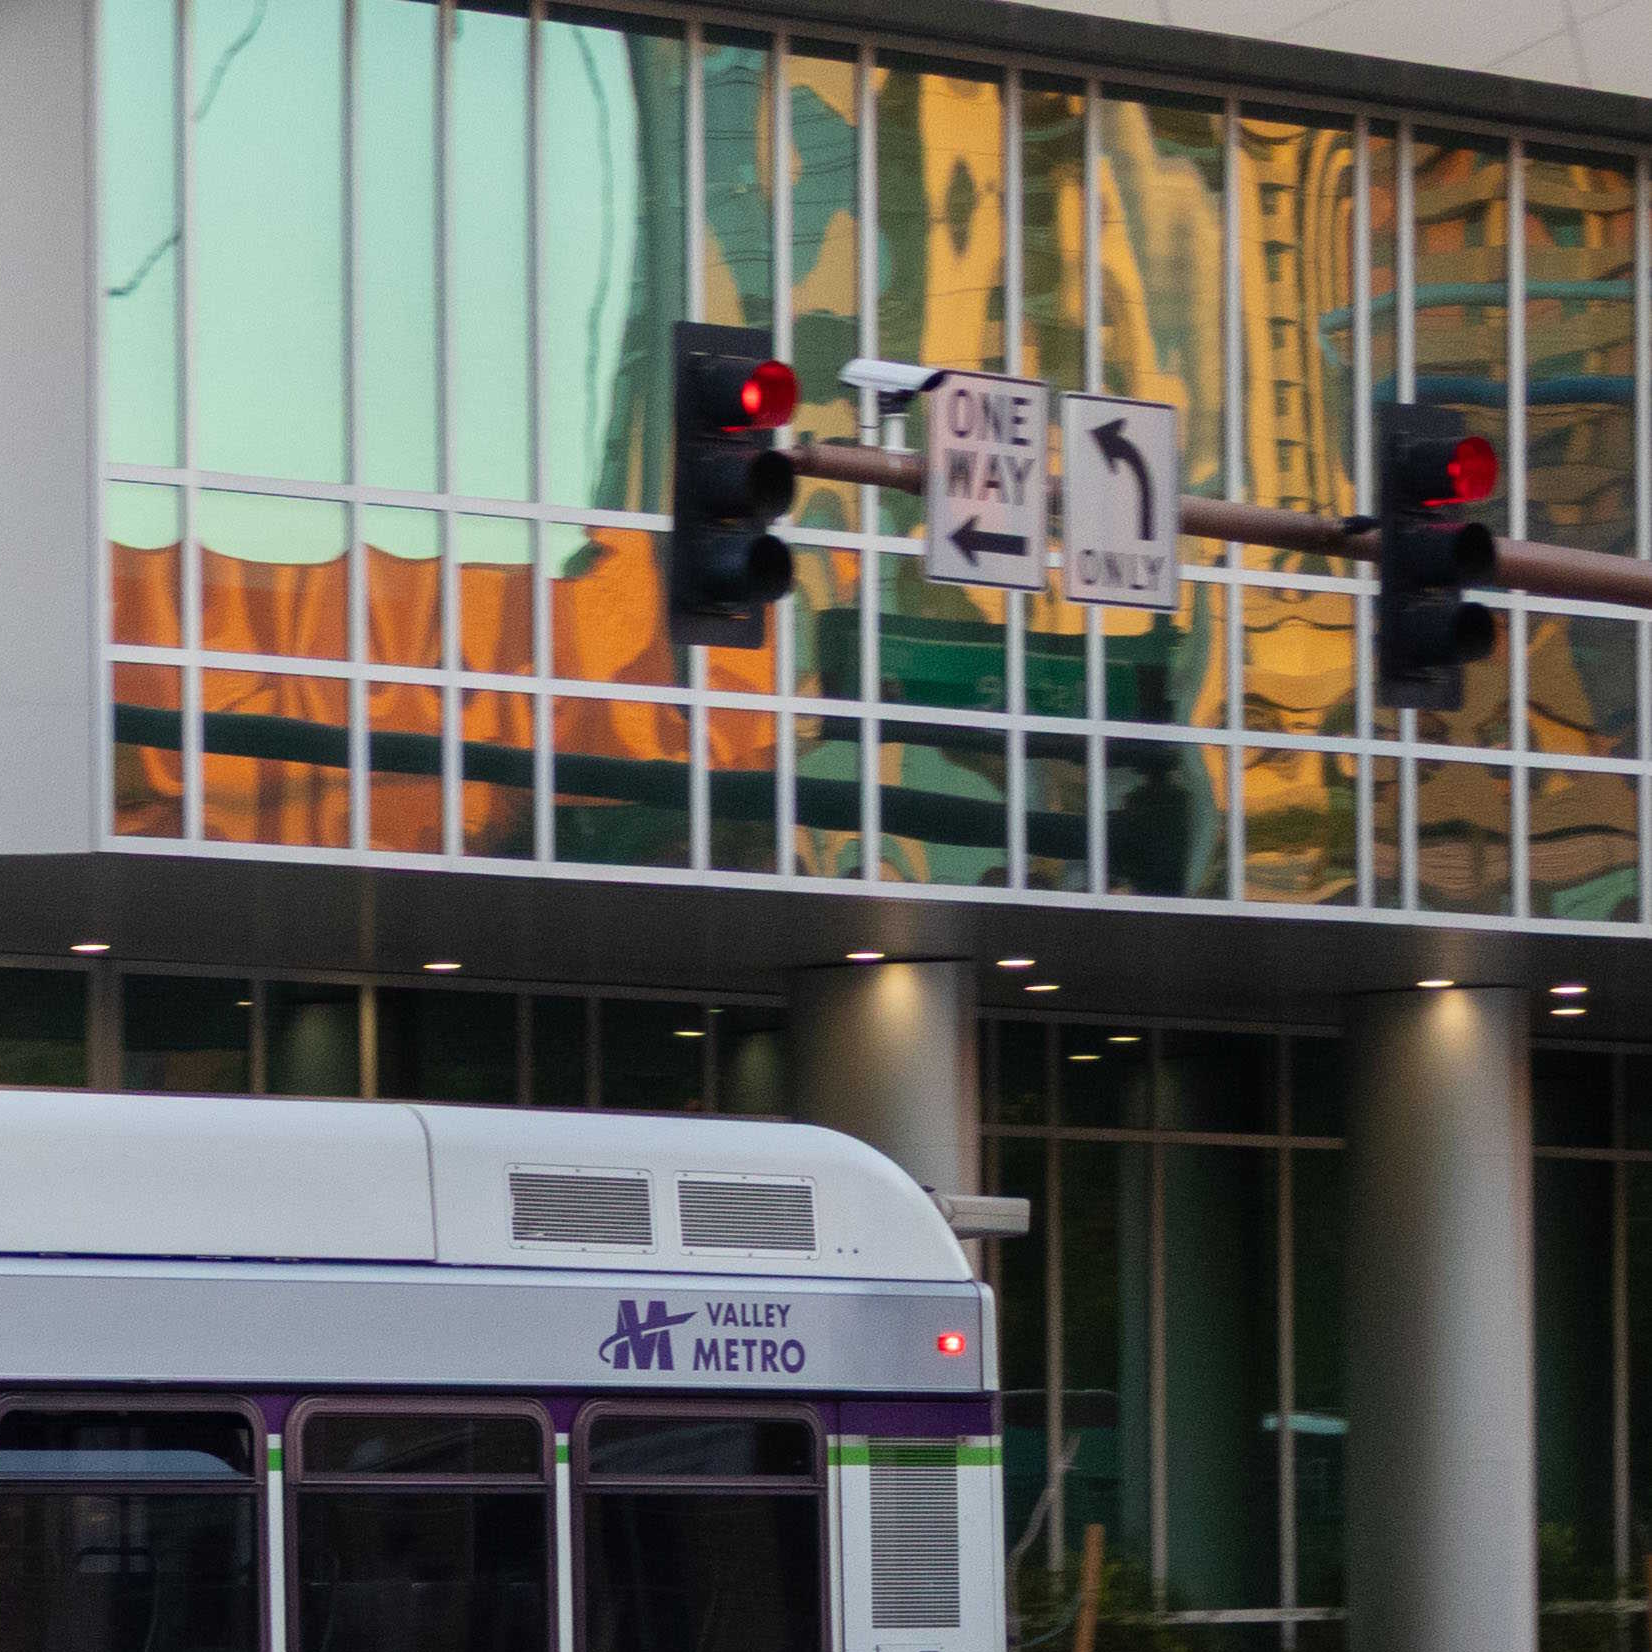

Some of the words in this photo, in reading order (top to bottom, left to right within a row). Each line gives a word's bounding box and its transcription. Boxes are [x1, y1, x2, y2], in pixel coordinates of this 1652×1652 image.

[946, 388, 1031, 446] ONE
[946, 450, 1035, 506] WAY
[1077, 548, 1165, 592] ONLY
[706, 1302, 791, 1328] VALLEY
[693, 1337, 806, 1373] METRO
